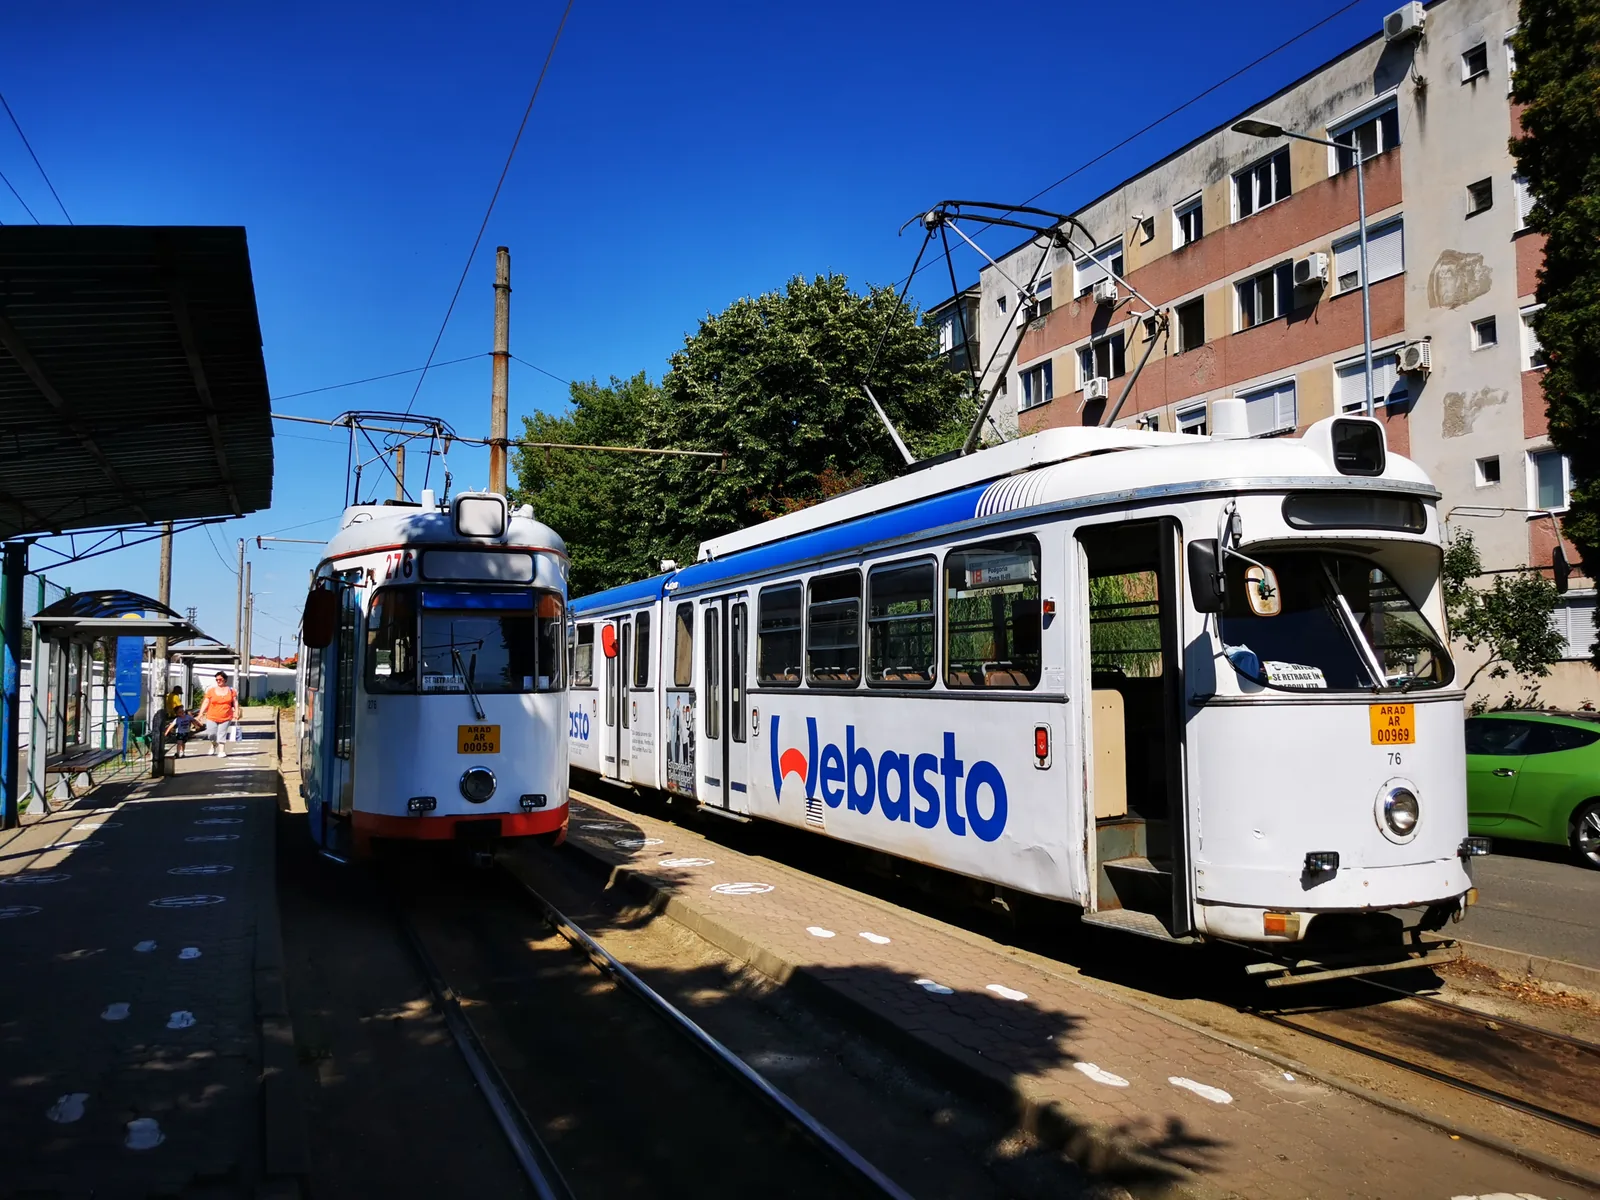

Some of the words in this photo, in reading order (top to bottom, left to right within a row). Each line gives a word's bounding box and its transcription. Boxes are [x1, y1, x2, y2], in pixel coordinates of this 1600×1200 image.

[386, 552, 413, 580] 276
[987, 565, 1008, 574] Podgoria
[424, 676, 432, 684] SE
[1272, 673, 1282, 681] SE
[1282, 672, 1312, 680] RETRAGE
[1380, 706, 1406, 715] ARAD
[1388, 716, 1400, 726] AR
[473, 733, 486, 741] AR
[1377, 728, 1409, 742] 00969
[463, 742, 494, 752] 00059
[1387, 752, 1402, 765] 76
[770, 714, 1008, 842] Webasto
